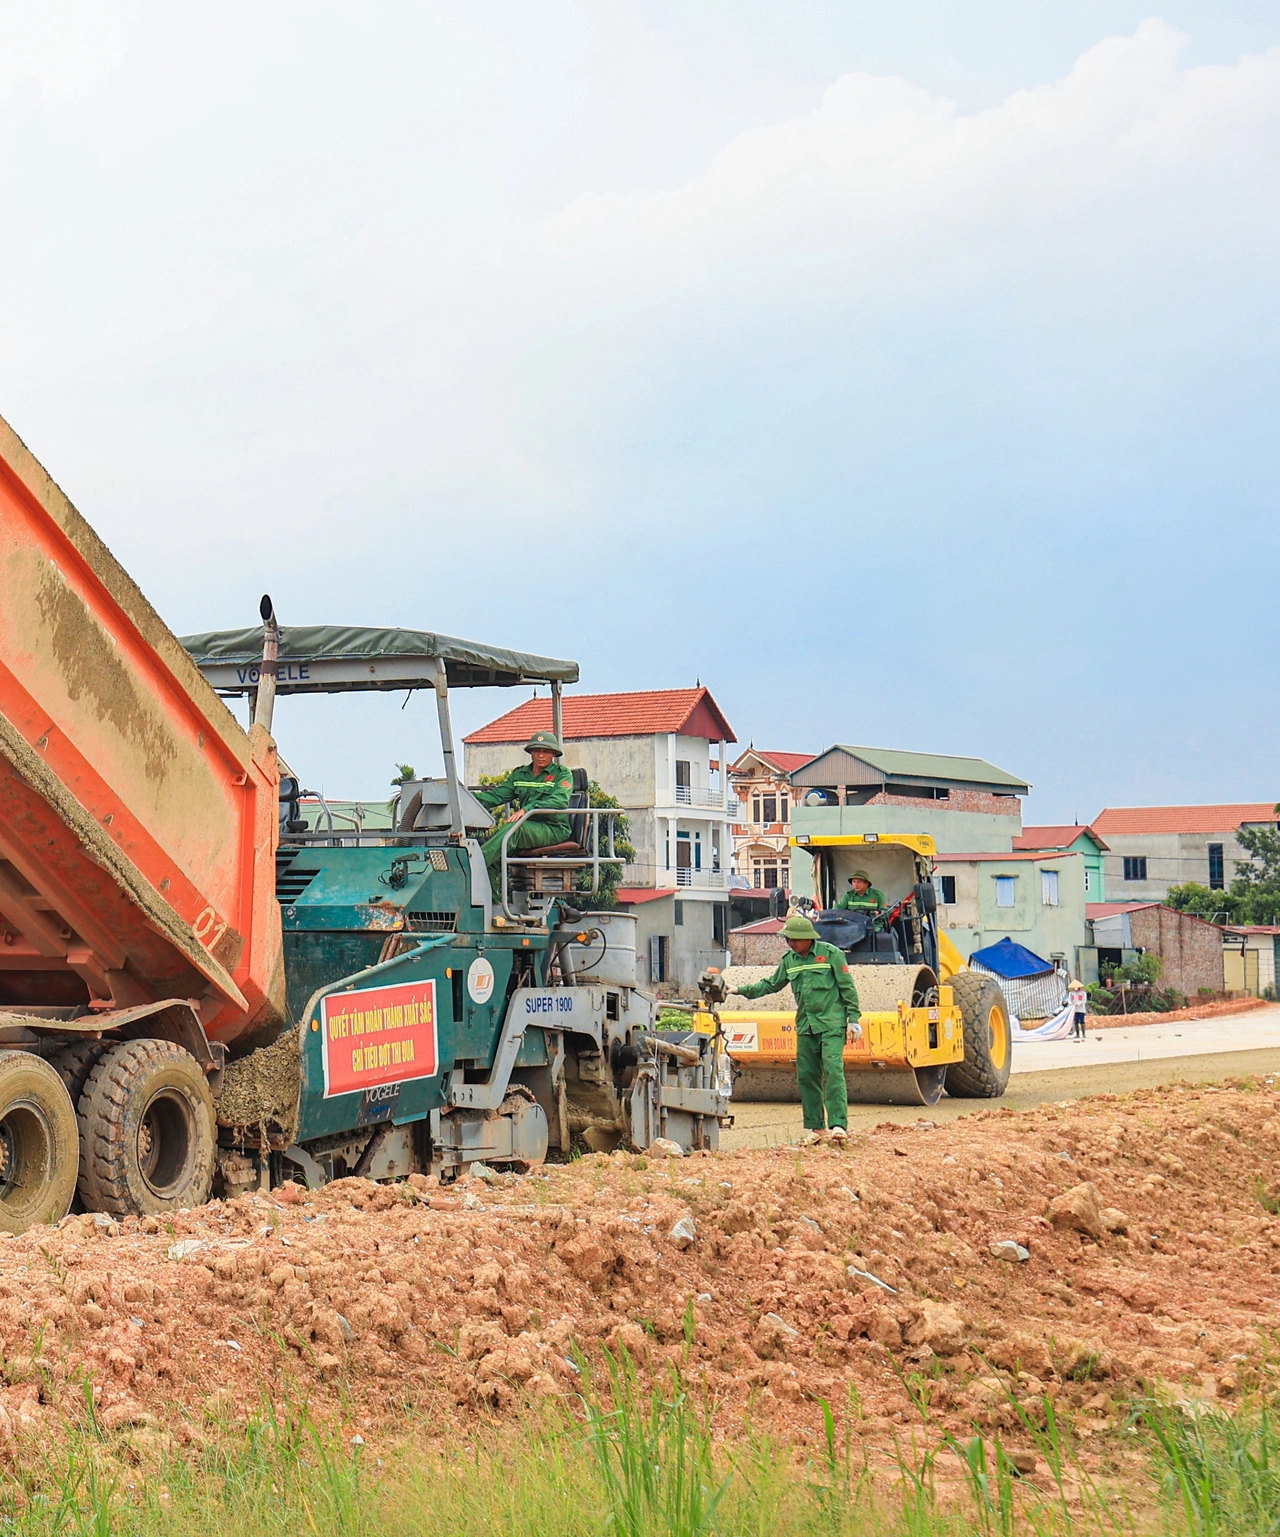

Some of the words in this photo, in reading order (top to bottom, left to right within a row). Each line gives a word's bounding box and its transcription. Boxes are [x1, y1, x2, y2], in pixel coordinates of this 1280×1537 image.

[236, 664, 310, 684] VÖELE
[192, 906, 228, 951] 01
[526, 997, 553, 1013] SUPER
[556, 997, 572, 1012] 1900
